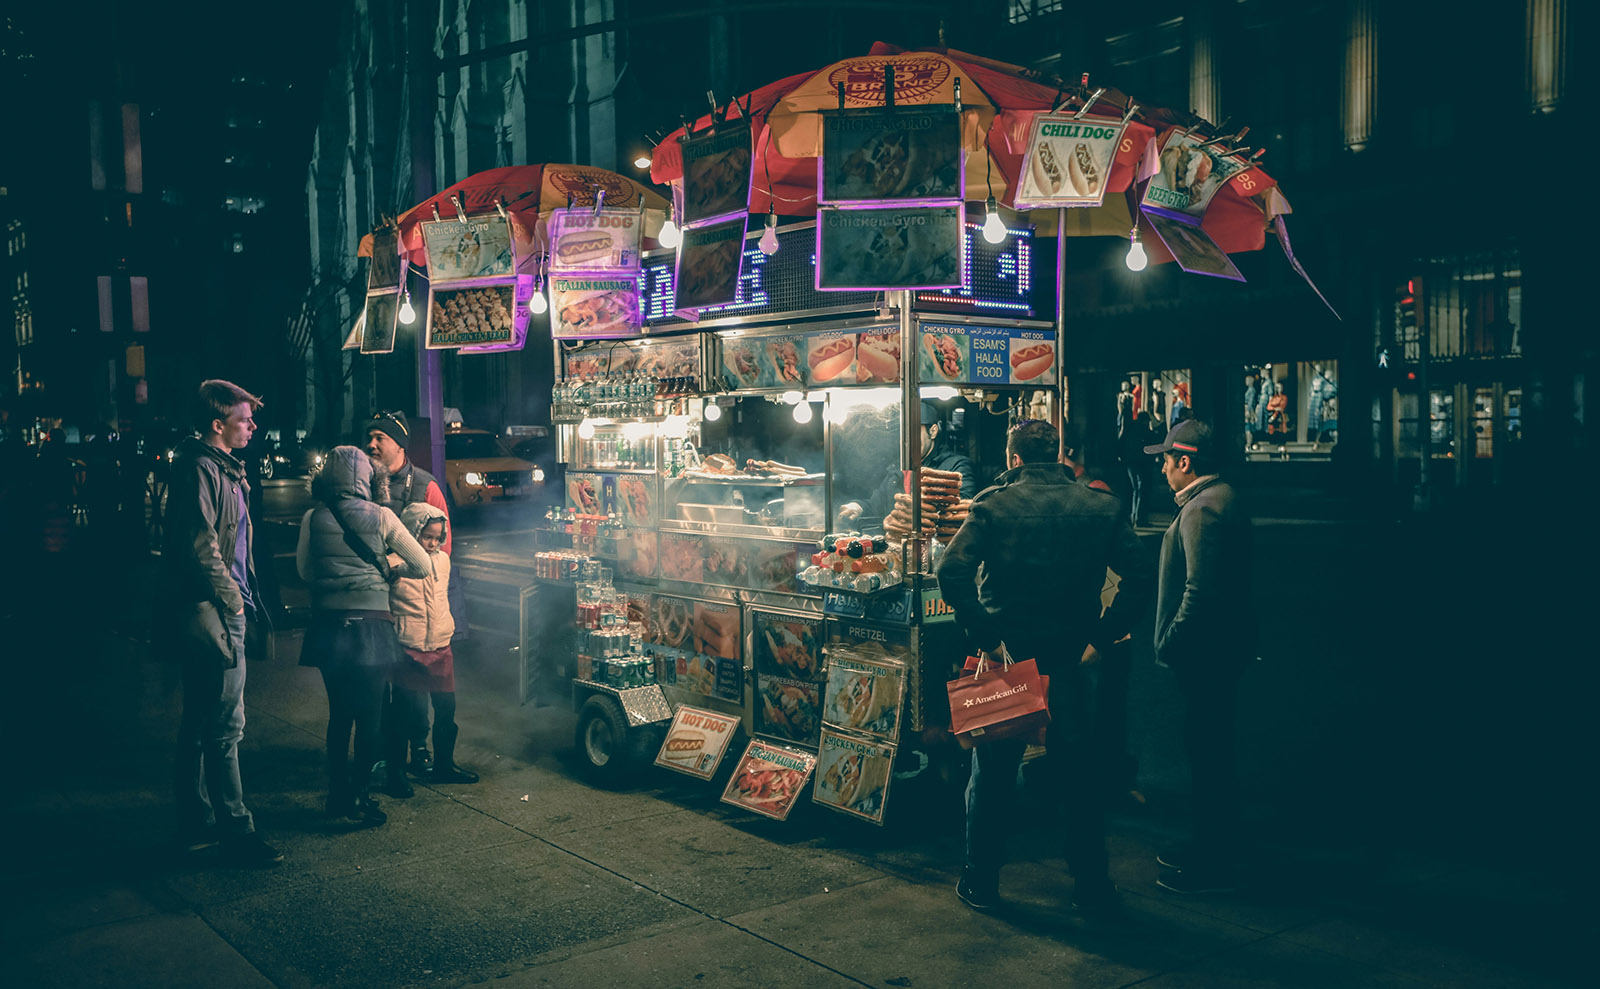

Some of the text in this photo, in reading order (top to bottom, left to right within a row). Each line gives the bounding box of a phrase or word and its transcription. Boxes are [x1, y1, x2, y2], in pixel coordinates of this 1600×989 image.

[1041, 124, 1116, 141] CHILI DOG
[1148, 185, 1190, 209] BEEF GYRO
[564, 216, 634, 229] HOT DOG
[829, 214, 887, 228] Chicken
[892, 214, 926, 229] Gyro
[427, 225, 467, 237] Chicken
[468, 223, 490, 234] Gyro
[556, 279, 633, 291] ITALIAN SAUSAGE
[433, 329, 510, 343] HALAL CHICKEN KEBAB
[882, 326, 897, 335] DOG
[923, 326, 966, 335] CHICKEN GYRO
[973, 338, 1006, 350] ESAM'S
[975, 353, 1004, 364] HALAL
[977, 366, 1003, 378] FOOD
[925, 598, 955, 616] HAL
[849, 626, 888, 642] PRETZEL
[681, 713, 728, 733] HOT DOG
[824, 736, 856, 751] CHICKEN
[775, 755, 807, 772] SAUSAGE
